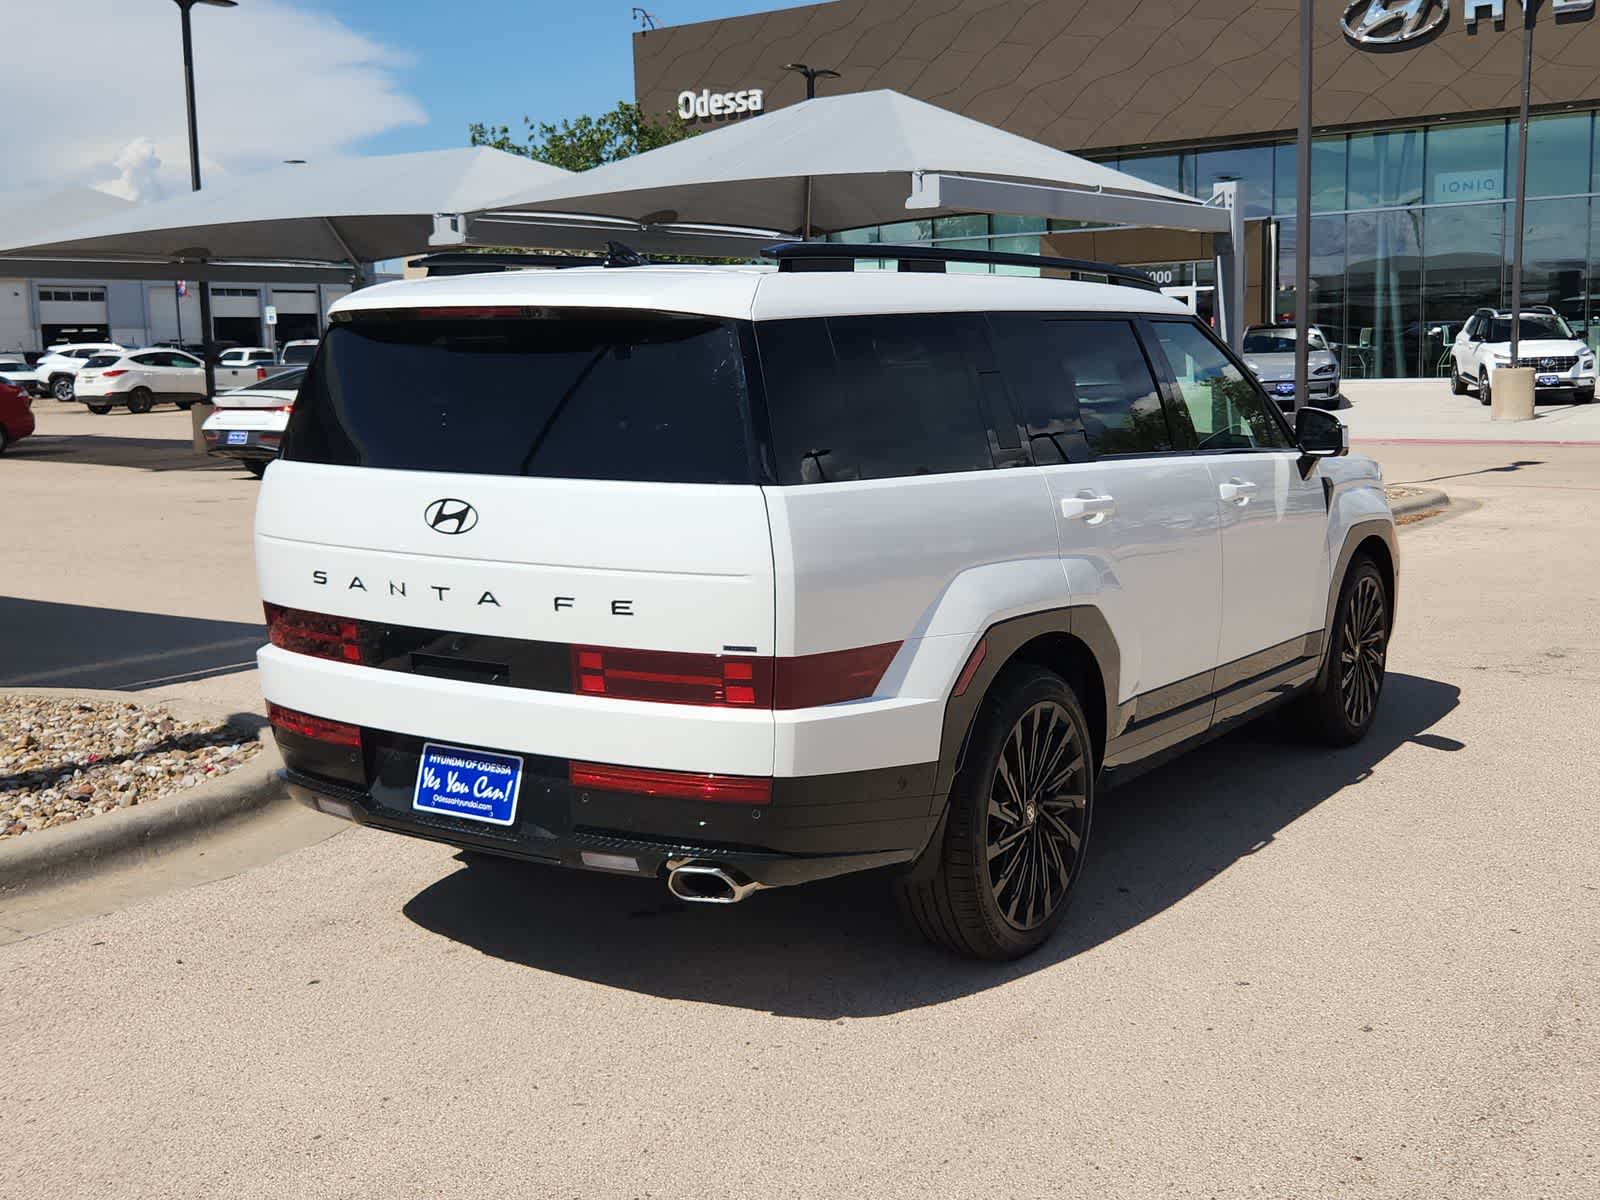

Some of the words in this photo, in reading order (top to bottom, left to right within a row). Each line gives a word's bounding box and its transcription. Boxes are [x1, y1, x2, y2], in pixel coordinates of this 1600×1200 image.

[678, 88, 763, 119] Odessa
[1442, 178, 1496, 193] IONIQ
[1145, 270, 1172, 284] 000
[312, 570, 501, 608] SANTA
[553, 596, 634, 616] FE
[429, 754, 464, 767] HYUNDAI
[465, 760, 478, 768] OF
[478, 763, 511, 775] ODESSA
[422, 766, 441, 790] Yes
[446, 771, 469, 794] You
[473, 776, 513, 802] Can!
